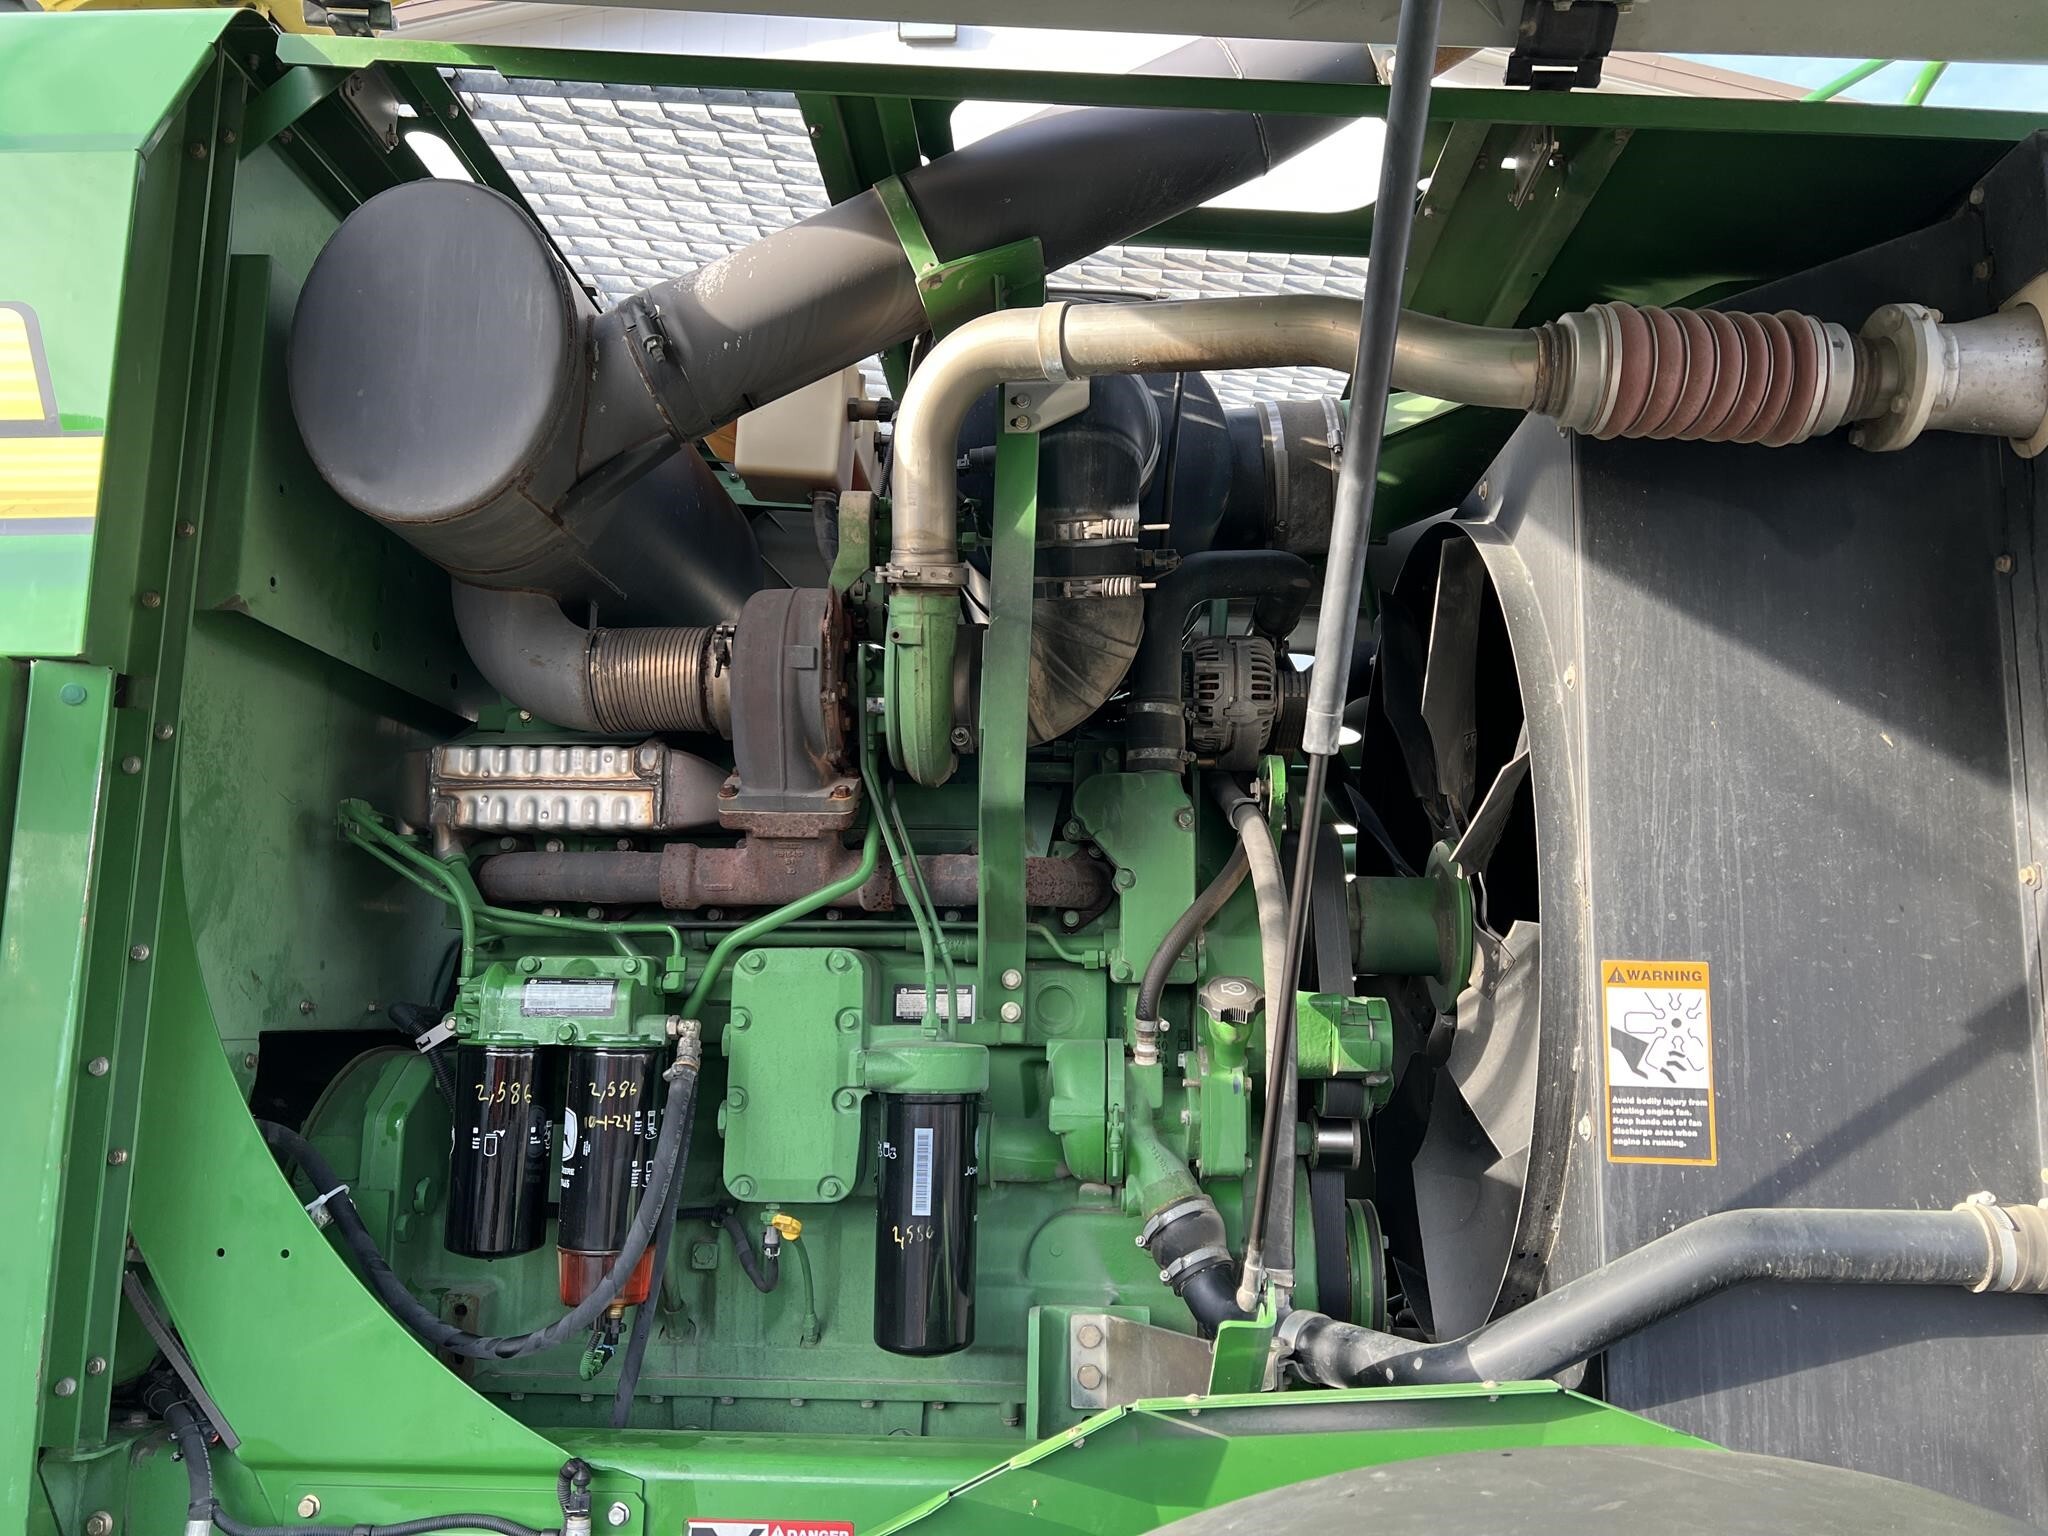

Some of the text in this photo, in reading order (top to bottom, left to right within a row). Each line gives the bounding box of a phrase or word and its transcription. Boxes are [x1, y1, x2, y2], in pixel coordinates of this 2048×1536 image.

[1627, 969, 1702, 982] WARNING
[475, 1081, 532, 1108] 2,586
[588, 1081, 637, 1104] 2,586
[1612, 1096, 1708, 1107] Avoid bodily injury from
[1612, 1107, 1693, 1117] rotating engine fan.
[584, 1114, 631, 1131] 10-1-24
[1612, 1117, 1703, 1127] Keep hands out of fan
[1613, 1127, 1653, 1137] discharge
[1675, 1128, 1698, 1137] when
[1613, 1138, 1687, 1148] engine is running.
